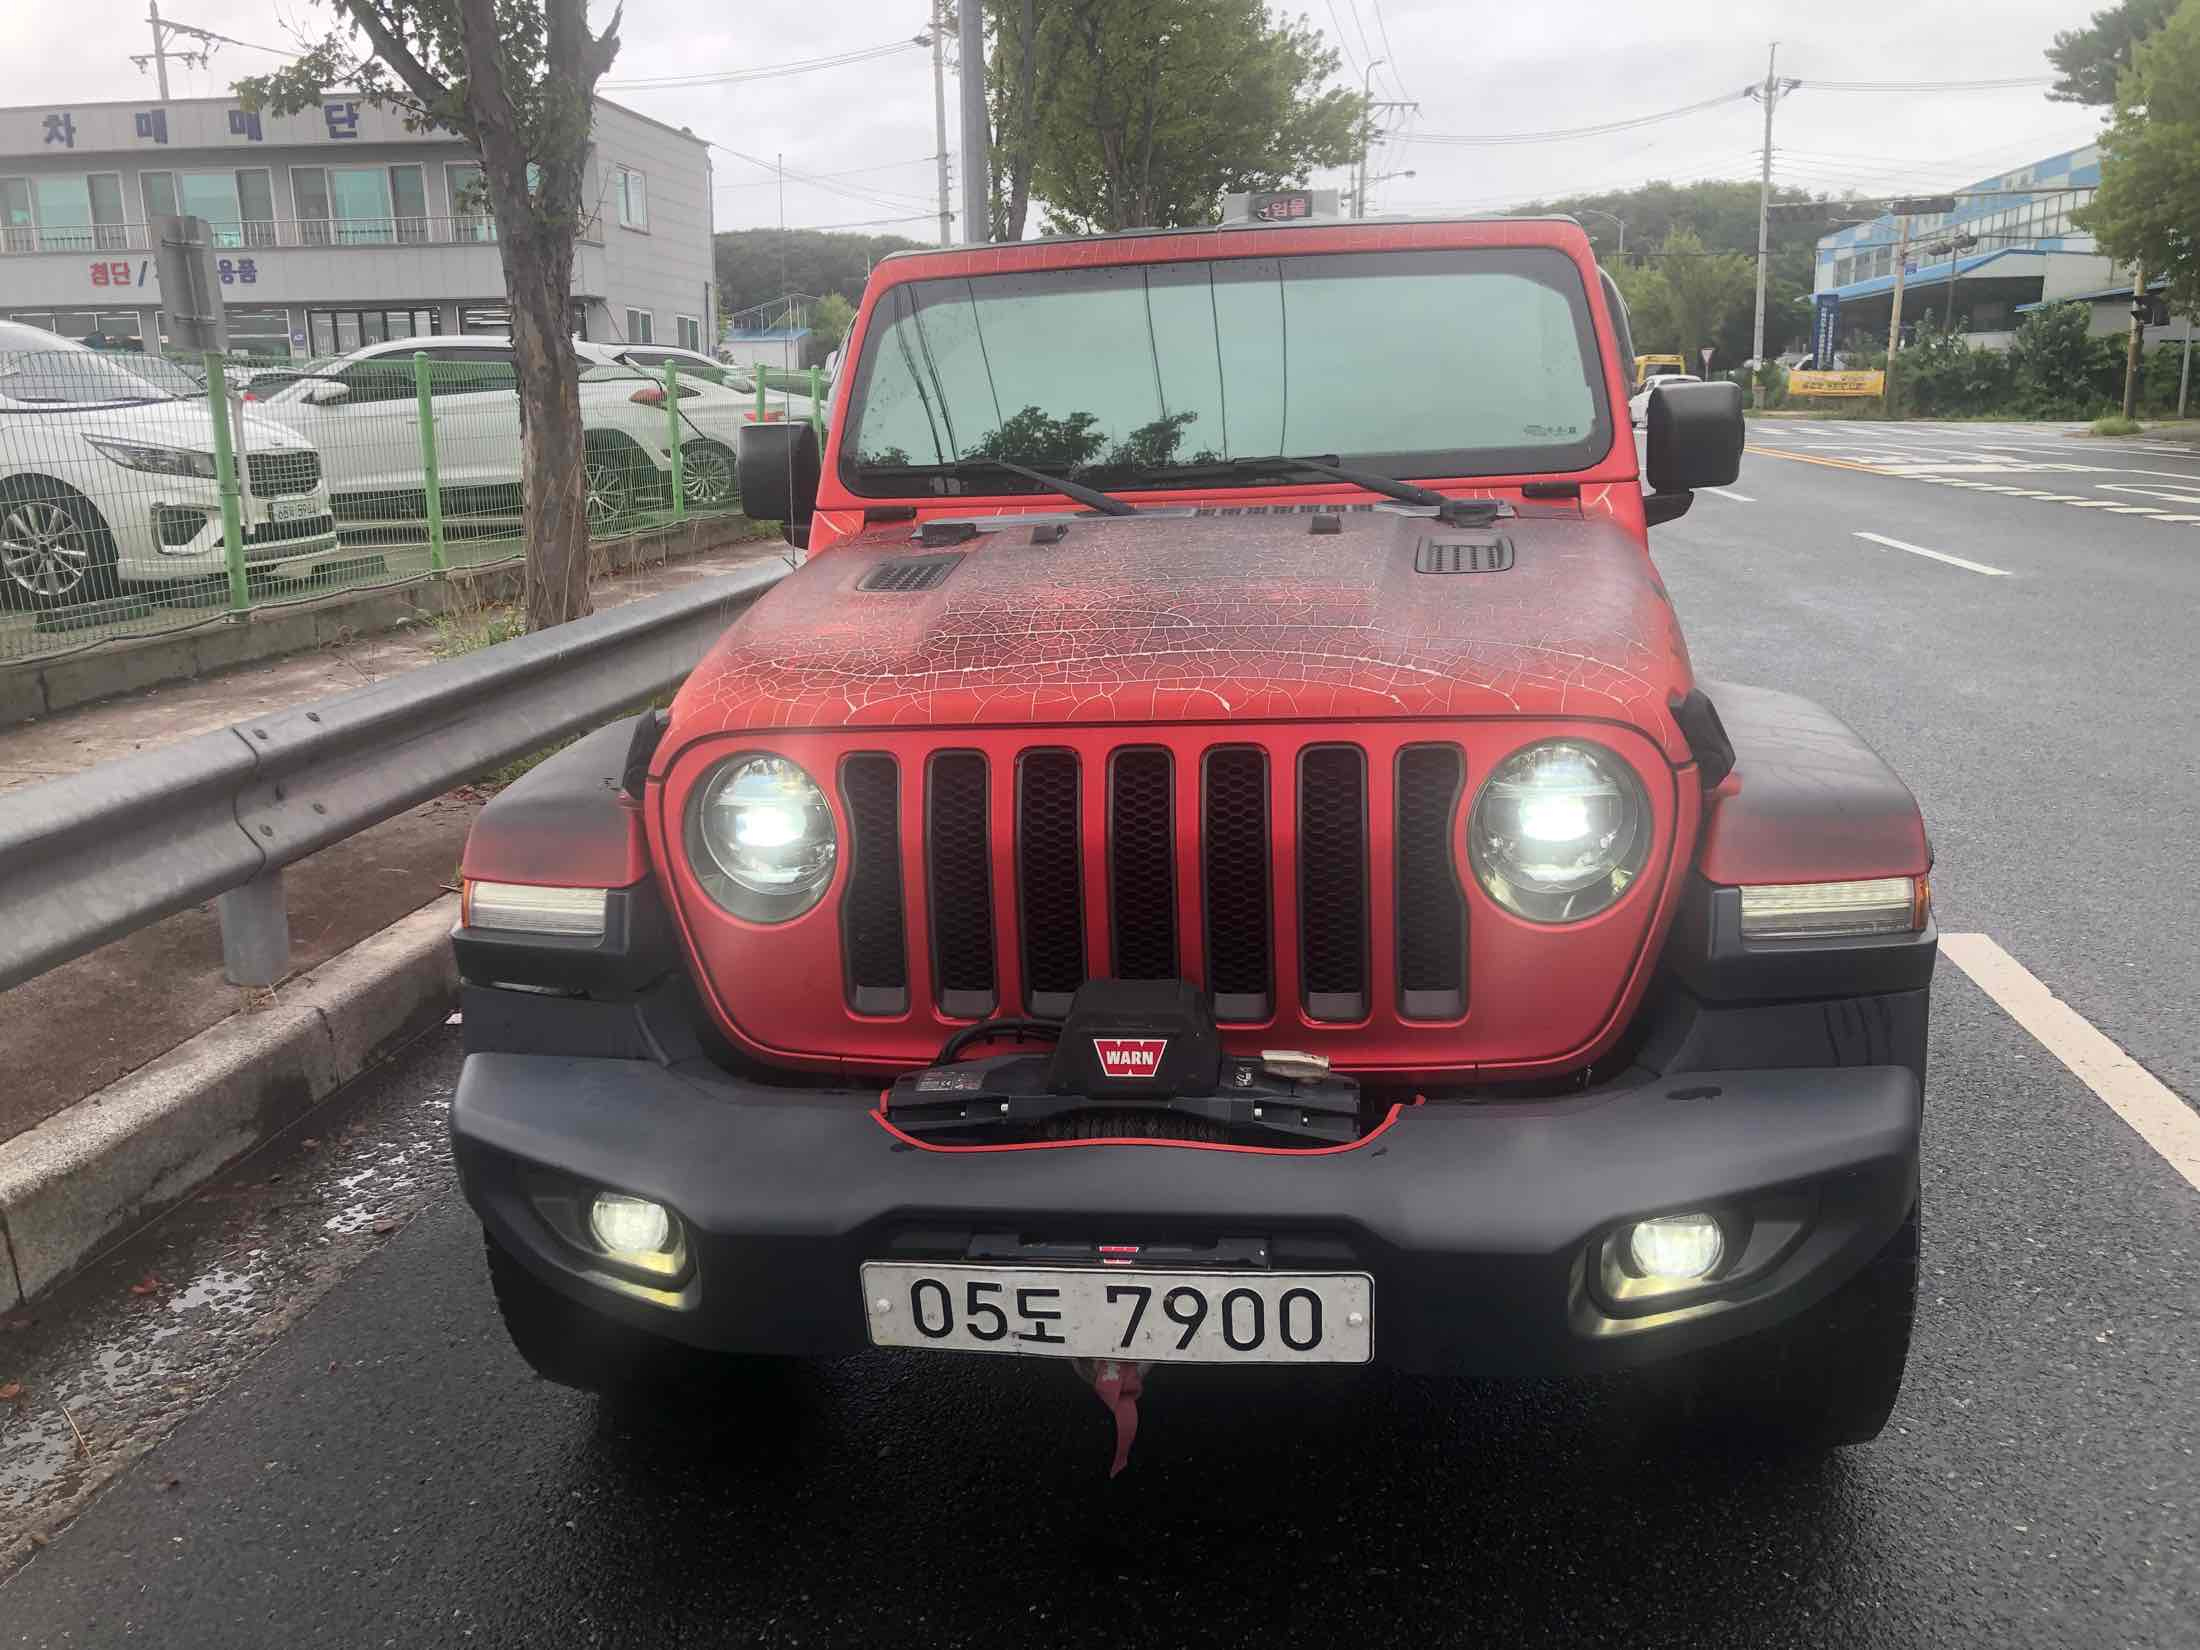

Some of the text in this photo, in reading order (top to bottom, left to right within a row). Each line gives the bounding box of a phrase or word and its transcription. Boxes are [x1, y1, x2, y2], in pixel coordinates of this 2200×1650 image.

[1106, 1050, 1154, 1065] WARN
[910, 1278, 1323, 1352] 05도 7900
